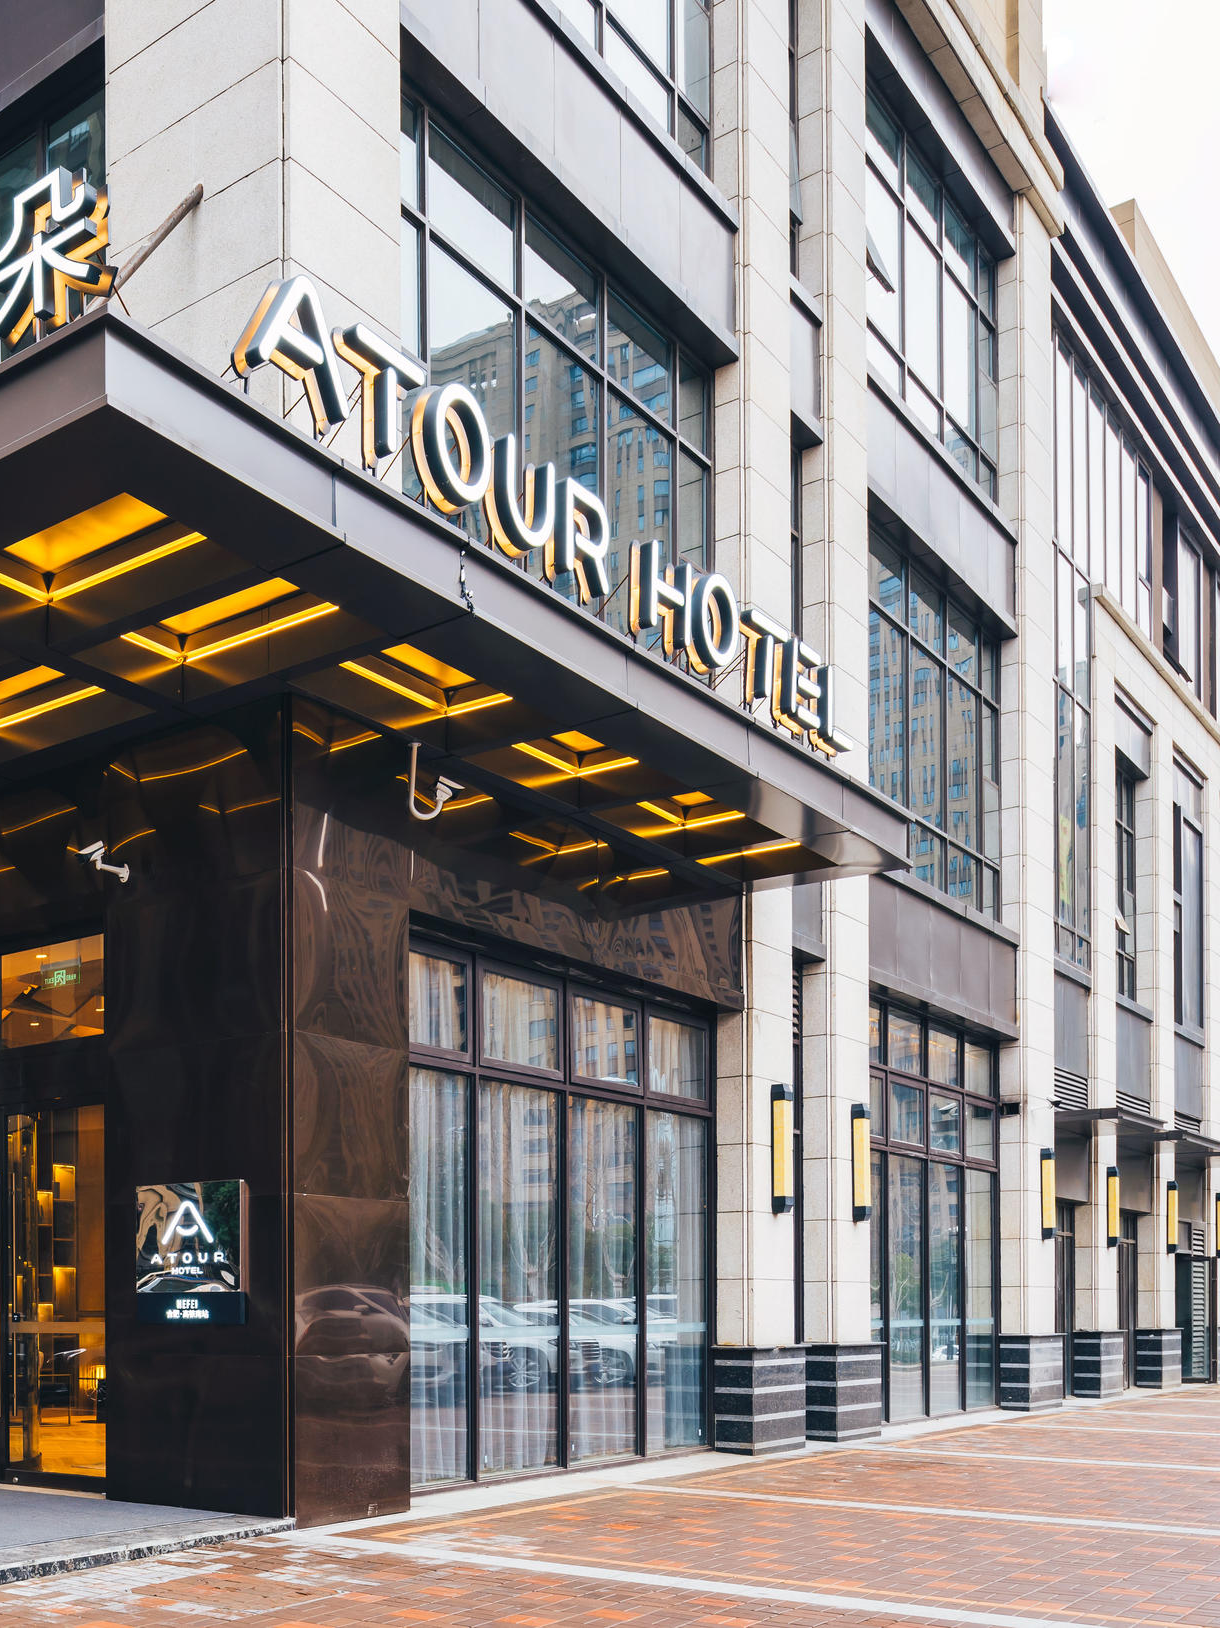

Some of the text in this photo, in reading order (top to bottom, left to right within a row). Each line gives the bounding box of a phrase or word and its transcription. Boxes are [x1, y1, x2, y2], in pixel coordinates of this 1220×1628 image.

[231, 274, 854, 758] ATOUR HOTEL
[150, 1251, 227, 1265] ATOUR
[171, 1266, 204, 1275] HOTEL
